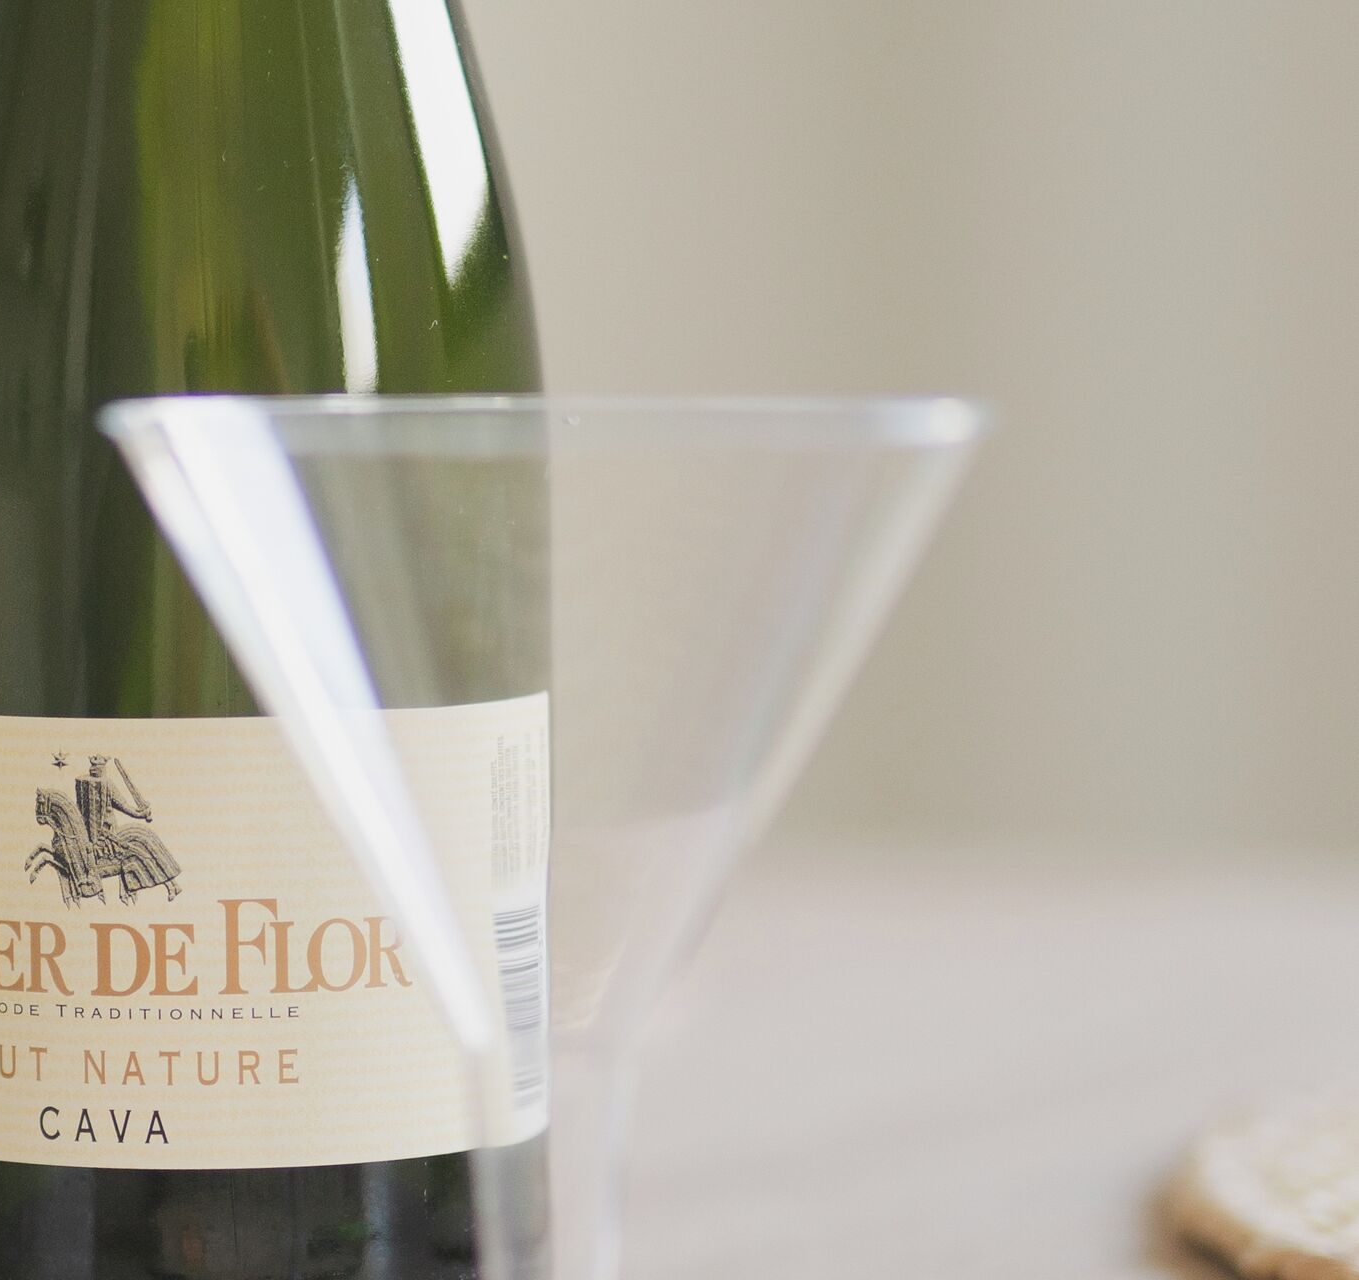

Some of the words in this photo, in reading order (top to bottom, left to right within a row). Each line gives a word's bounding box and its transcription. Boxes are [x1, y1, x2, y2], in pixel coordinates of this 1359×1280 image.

[89, 923, 198, 997] DE
[217, 898, 414, 995] FLOR
[55, 1004, 300, 1020] TRADITIONNELLE
[83, 1048, 300, 1086] NATURE
[39, 1106, 170, 1144] CAVA
